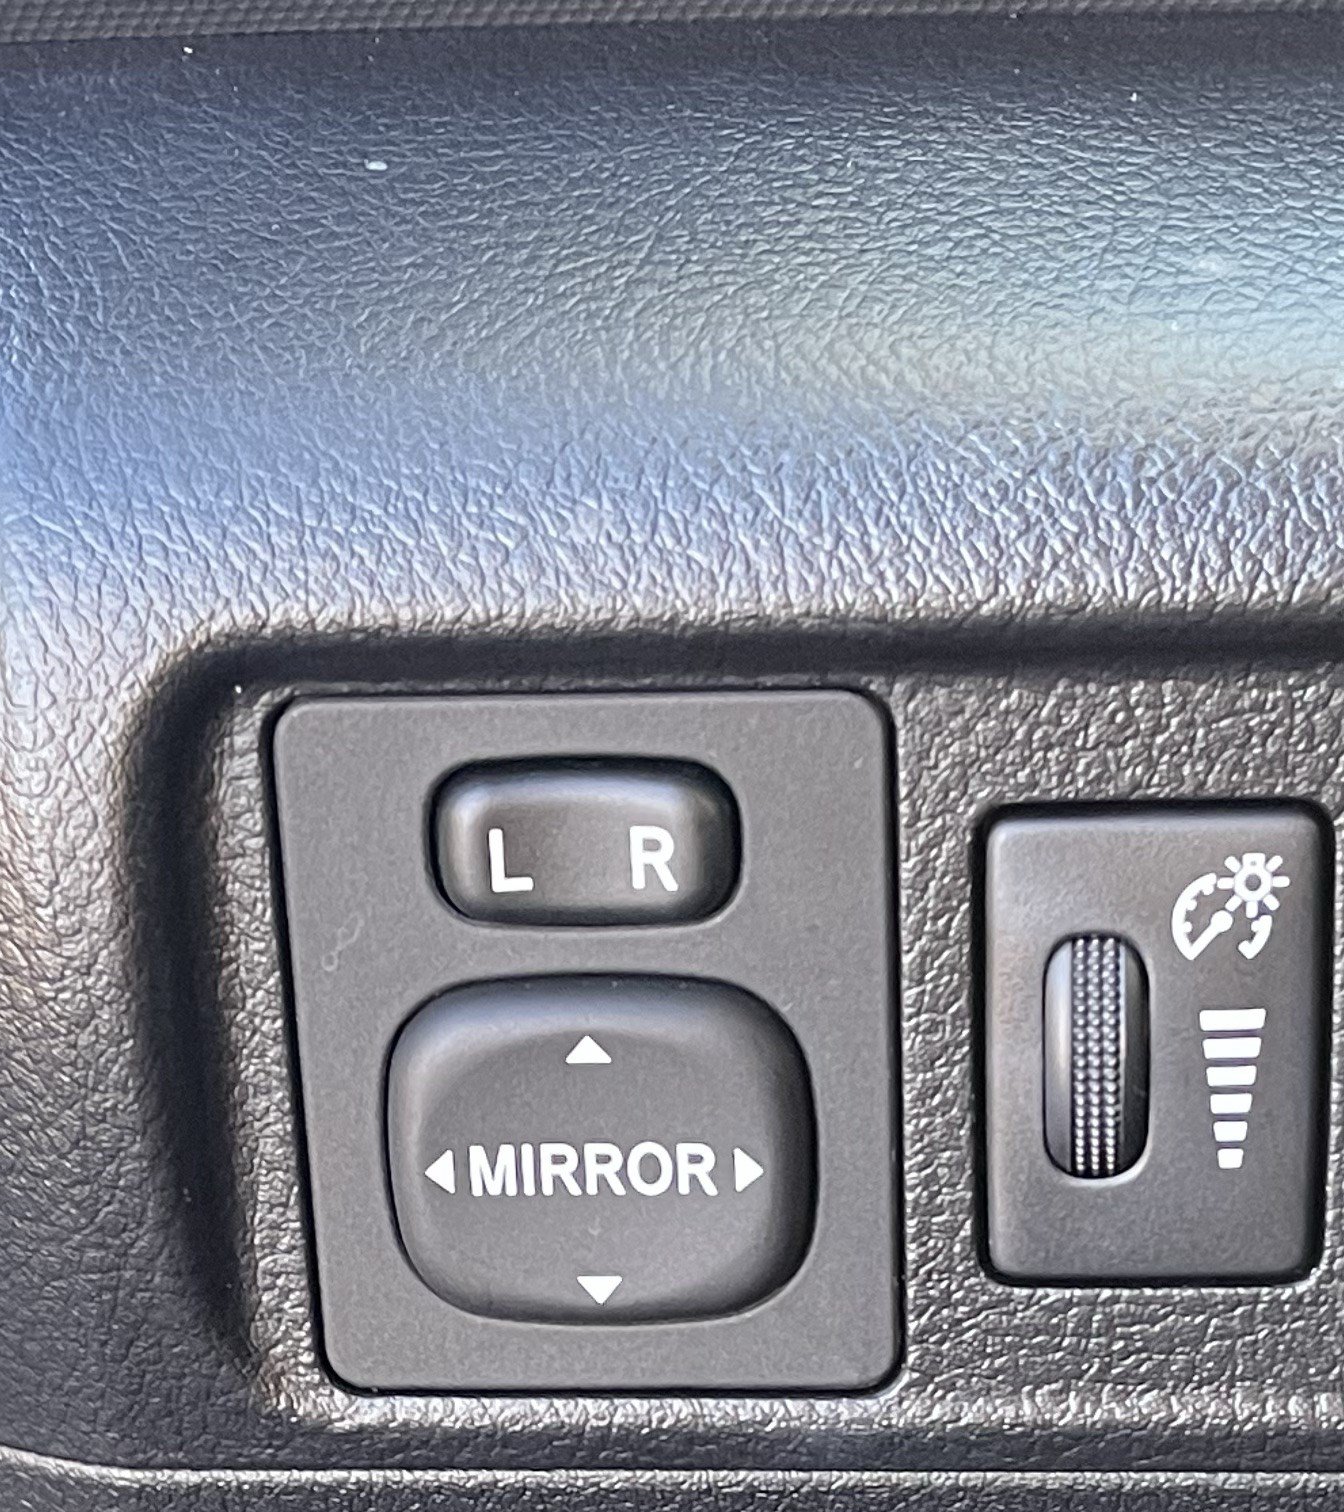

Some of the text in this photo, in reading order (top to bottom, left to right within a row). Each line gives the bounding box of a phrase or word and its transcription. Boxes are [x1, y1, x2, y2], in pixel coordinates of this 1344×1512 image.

[487, 825, 679, 893] L R
[468, 1141, 719, 1198] MIRROR
